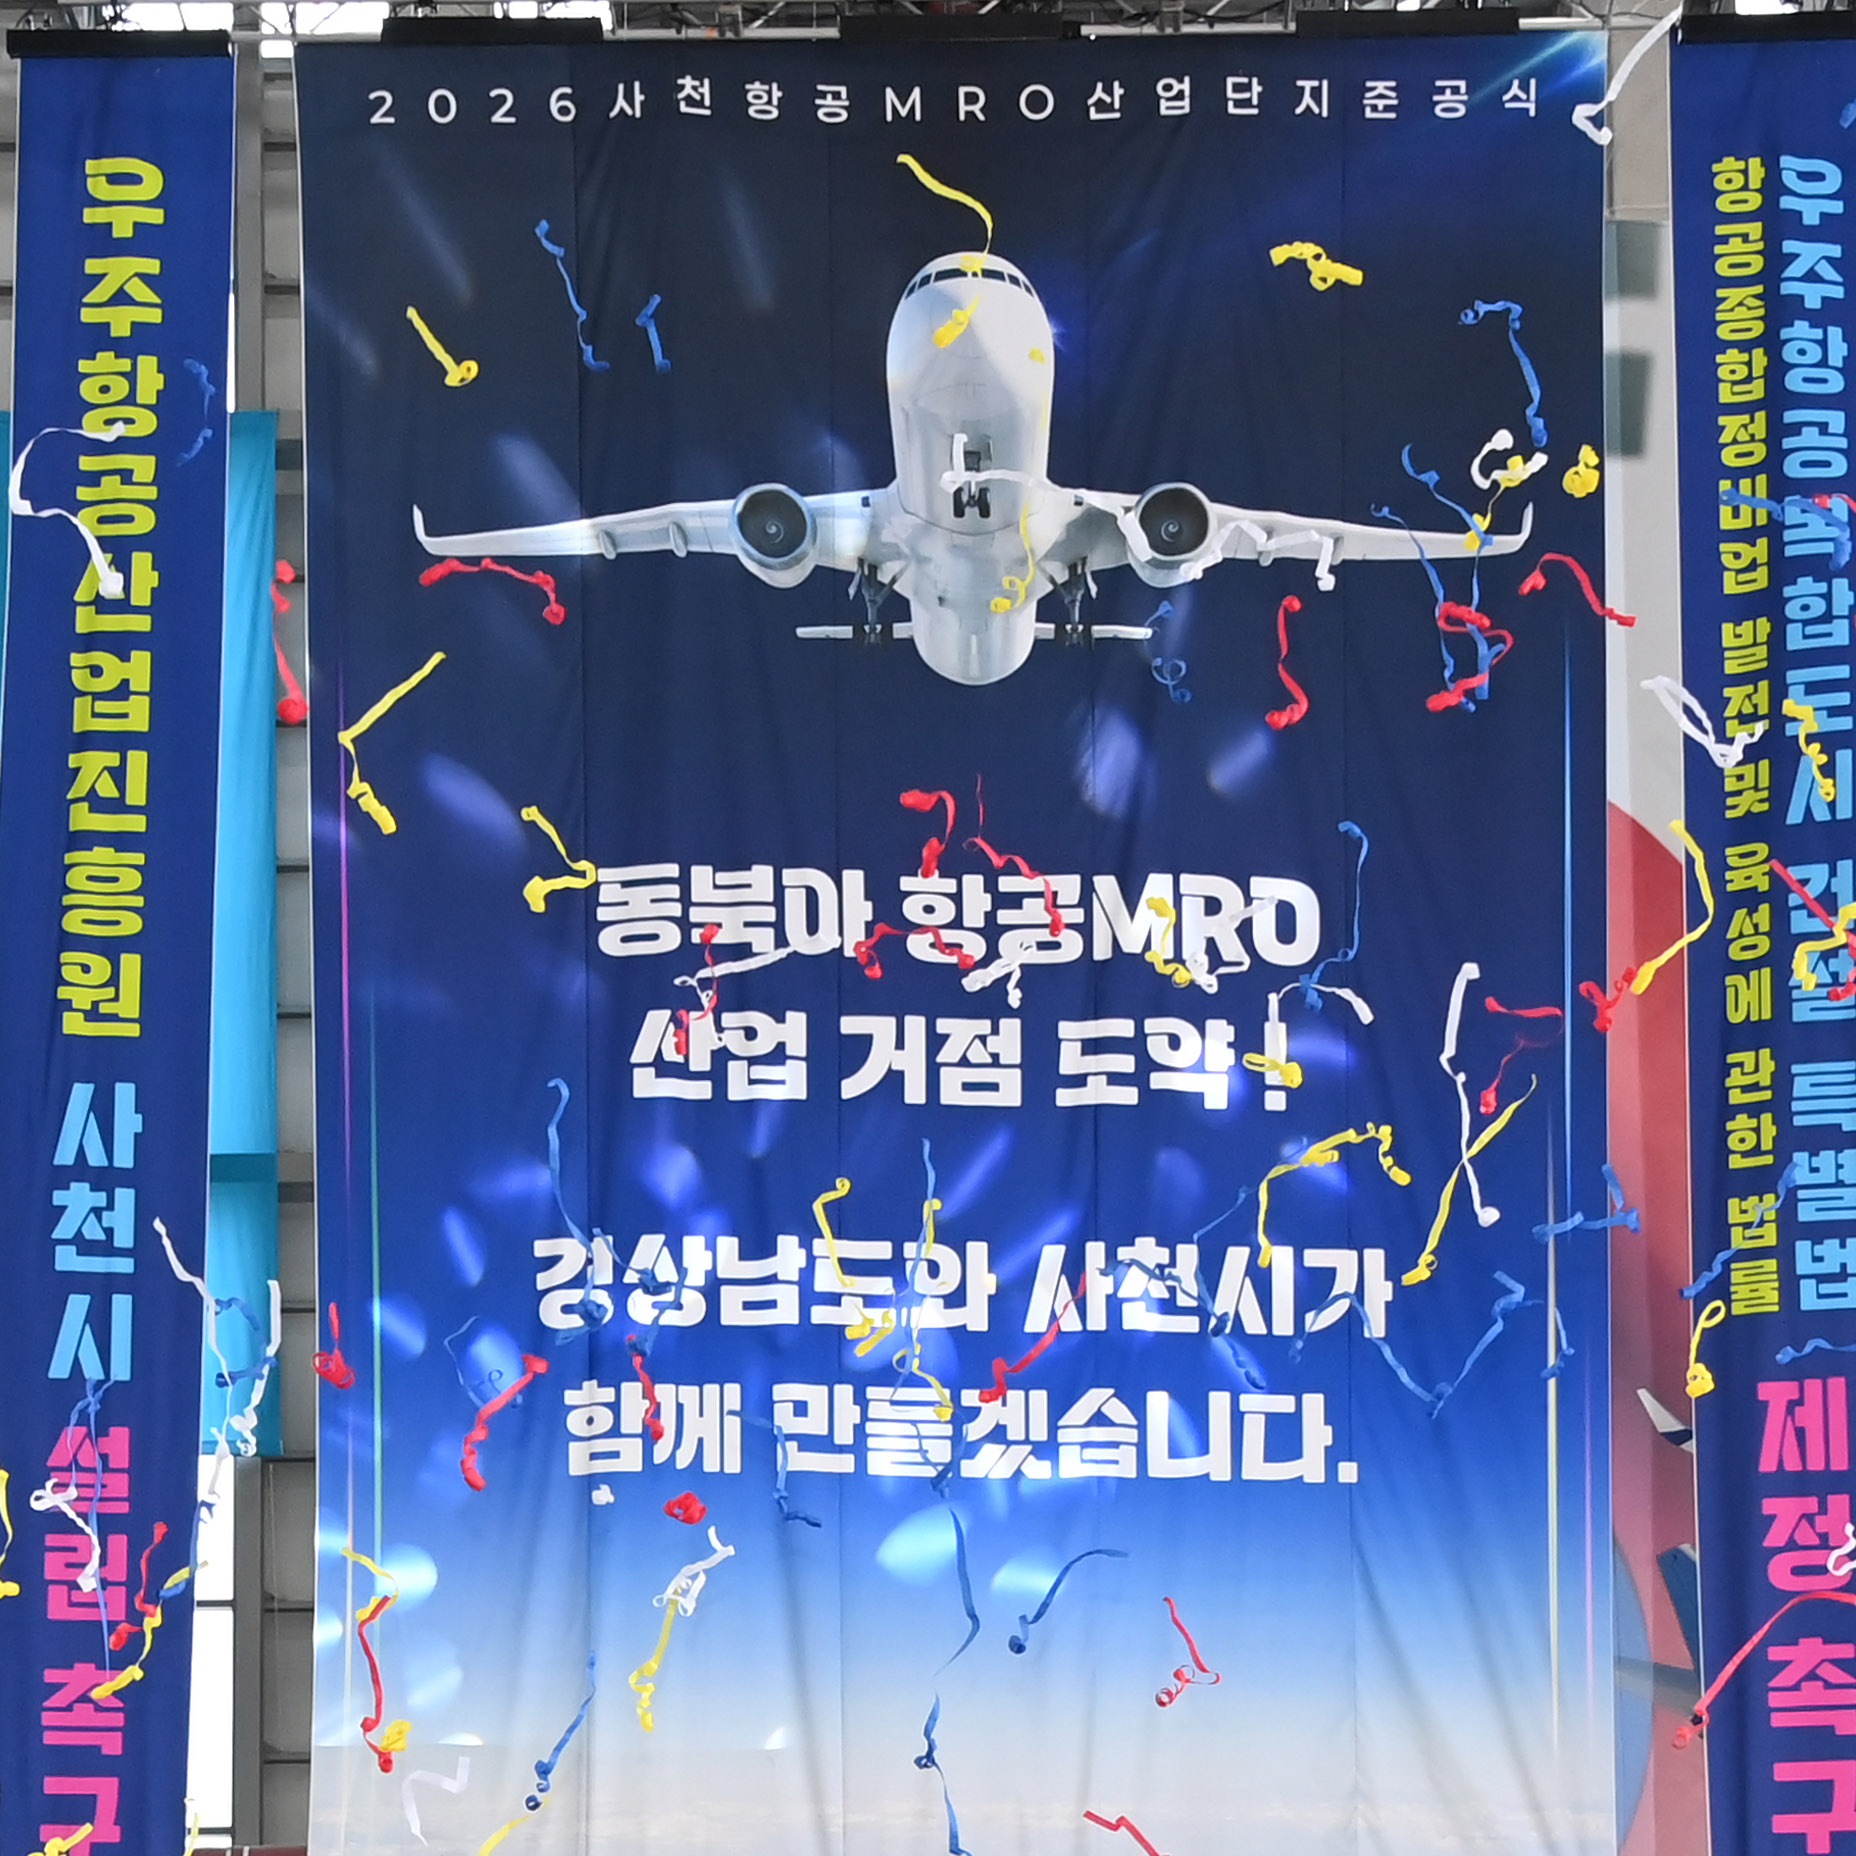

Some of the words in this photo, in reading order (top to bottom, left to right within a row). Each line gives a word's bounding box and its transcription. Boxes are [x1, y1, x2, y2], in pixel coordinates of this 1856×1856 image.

[56, 157, 165, 1038] 우주항공산업진흥원
[1721, 616, 1772, 738] 발전
[1724, 758, 1771, 819] 및
[595, 862, 872, 958] 동북아
[898, 866, 1320, 967] 항공MRO
[1725, 841, 1773, 1024] 육성에
[630, 1011, 807, 1101] 산업
[839, 1014, 1022, 1108] 거점
[1725, 1047, 1778, 1170] 관한
[47, 1081, 142, 1381] 사천시
[533, 1233, 994, 1334] 경상남도와
[1023, 1236, 1392, 1340] 사천시가
[1727, 1192, 1781, 1316] 법률
[564, 1377, 742, 1478] 함께
[771, 1380, 1358, 1486] 만들겠습니다.
[1757, 1376, 1854, 1593] 제정
